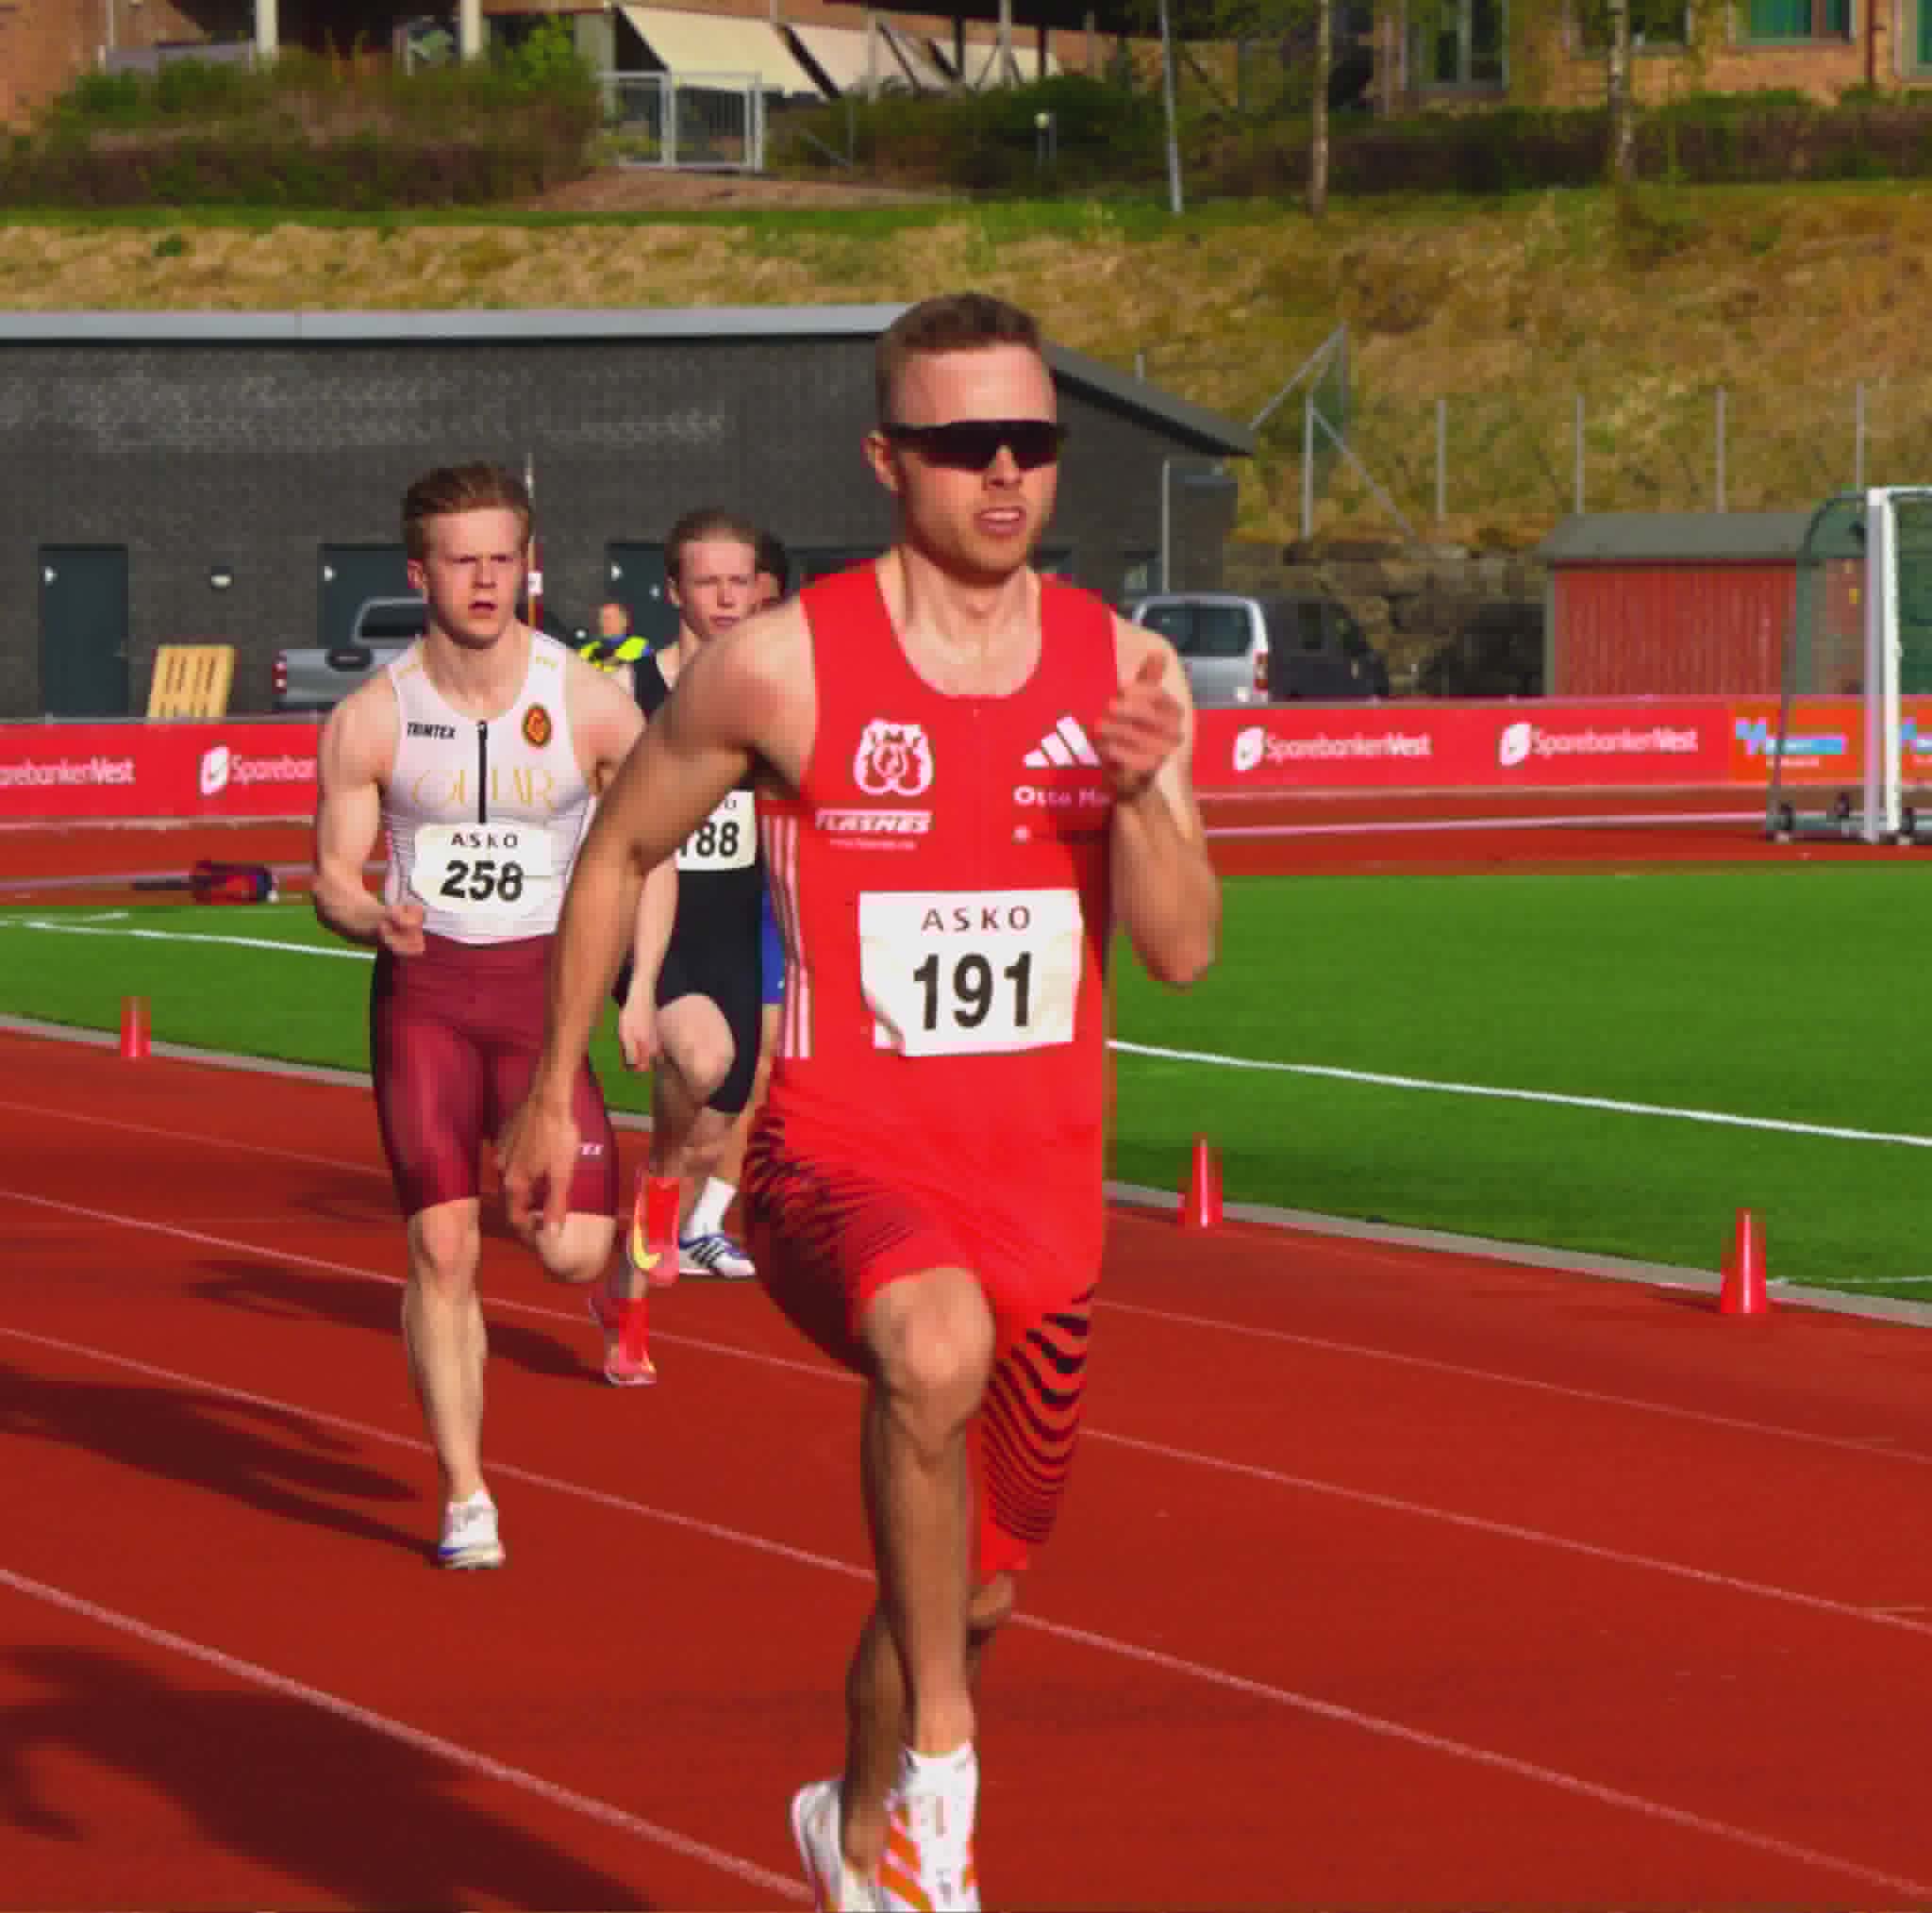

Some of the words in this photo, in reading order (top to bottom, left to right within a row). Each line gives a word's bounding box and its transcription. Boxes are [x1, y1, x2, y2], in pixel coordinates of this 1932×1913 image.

[451, 832, 519, 848] ASKO
[440, 859, 525, 902] 258
[922, 906, 1031, 932] ASKO
[912, 951, 1032, 1030] 191
